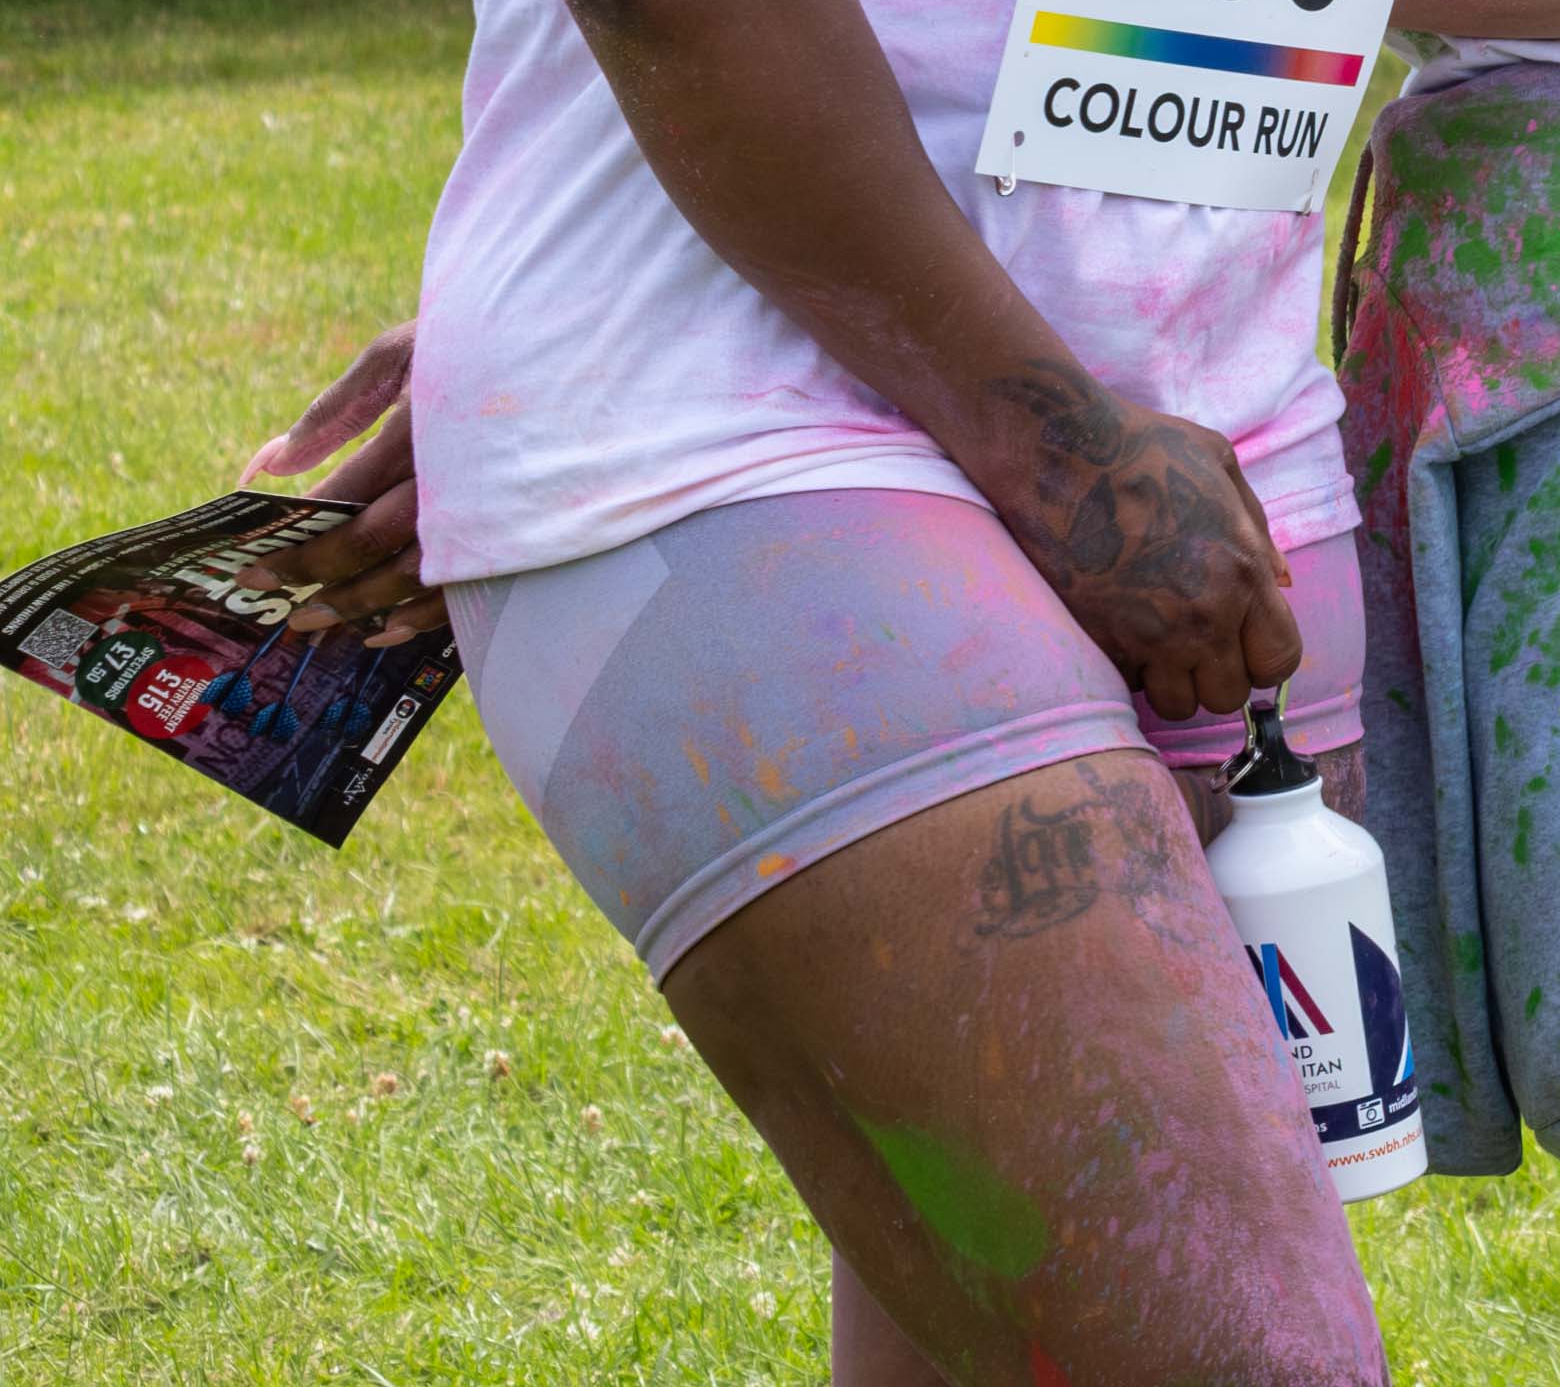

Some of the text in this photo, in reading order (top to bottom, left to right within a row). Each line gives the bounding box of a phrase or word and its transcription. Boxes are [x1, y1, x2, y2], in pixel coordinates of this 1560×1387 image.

[1044, 77, 1329, 158] COLOUR RUN
[85, 640, 135, 684] £7.50
[104, 646, 155, 700] SPECTATORS
[136, 667, 182, 714] £15
[156, 678, 195, 721] ENTRY FEE
[163, 679, 210, 733] TOURNAMENT
[1304, 1079, 1341, 1094] SPITAL
